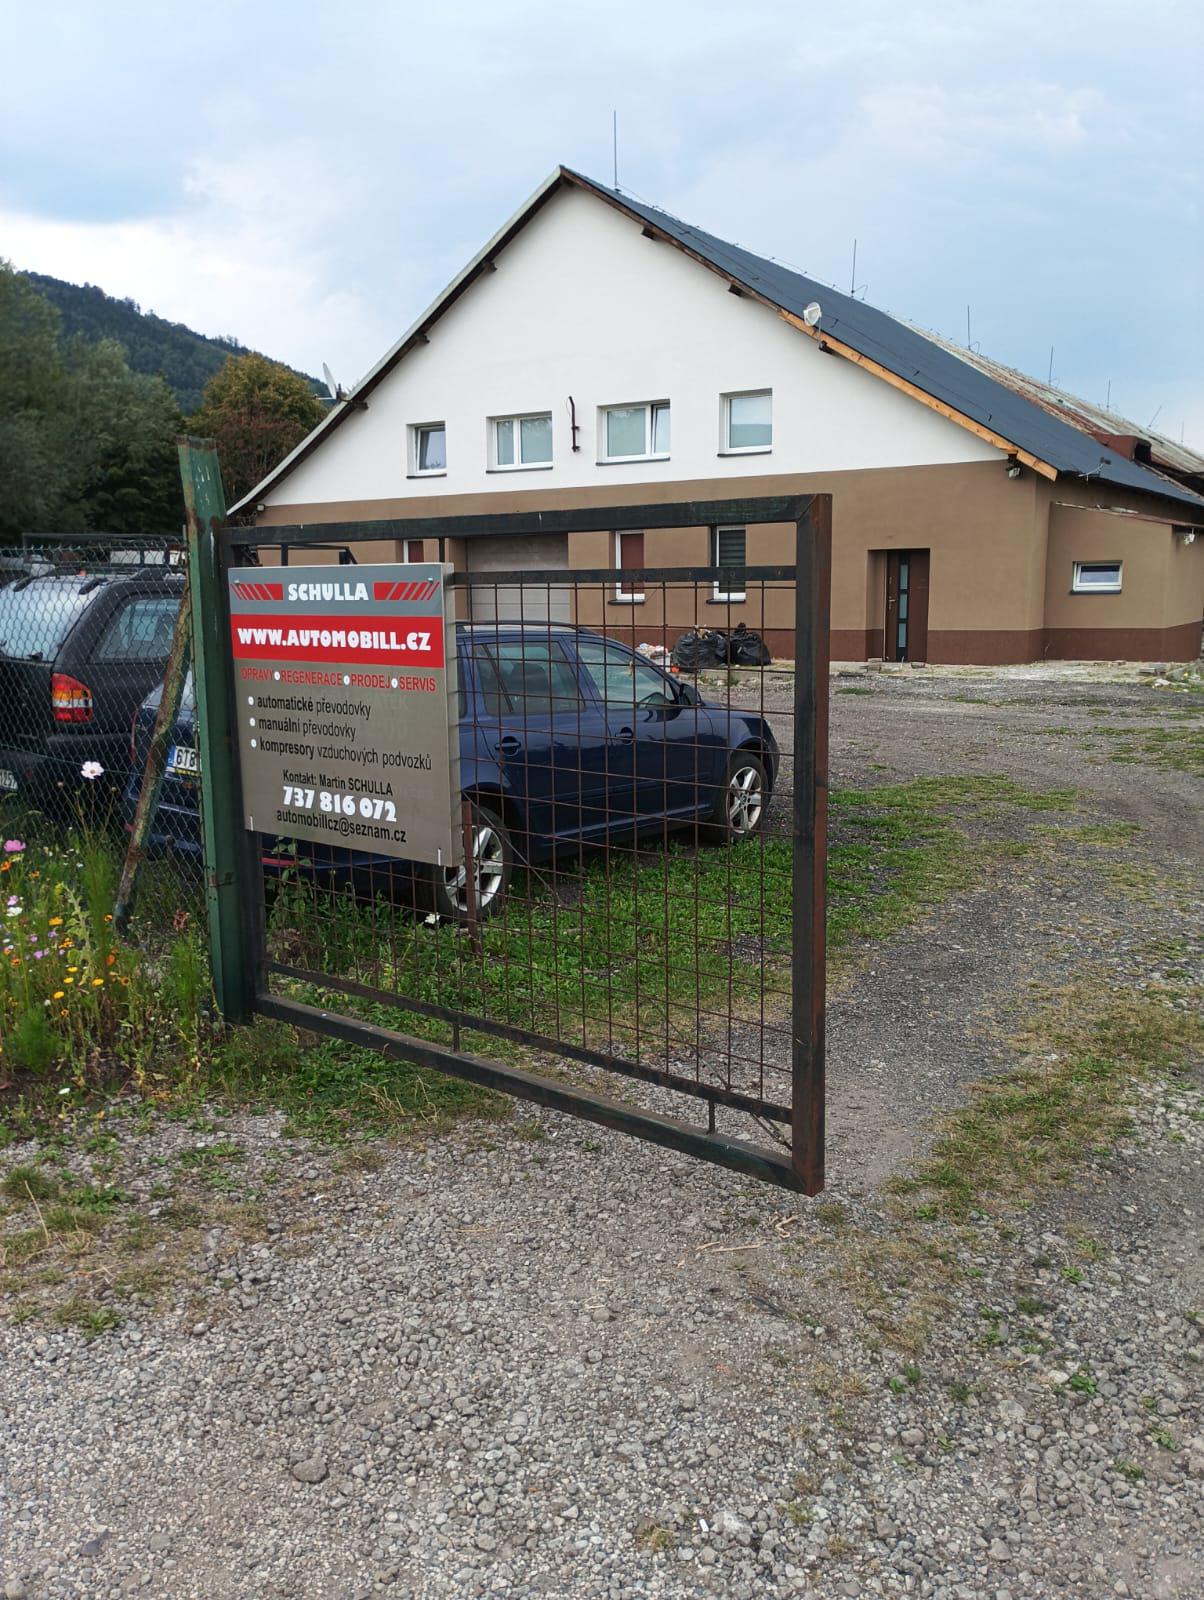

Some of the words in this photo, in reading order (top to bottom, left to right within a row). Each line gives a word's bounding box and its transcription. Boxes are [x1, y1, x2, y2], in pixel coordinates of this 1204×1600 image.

[288, 582, 369, 601] SCHULLA
[237, 628, 432, 651] WWW.AUTOMOBILL.CZ
[240, 667, 274, 681] OPRAVY
[280, 669, 343, 686] REGENERACE
[350, 672, 391, 689] PRODEJ
[399, 676, 437, 692] SERVIS
[257, 696, 314, 712] automatické
[316, 698, 371, 720] převodovky
[258, 717, 300, 733] manuální
[303, 720, 356, 742] převodovky
[260, 736, 315, 760] kompresory
[318, 744, 378, 766] vzduchových
[382, 751, 432, 771] podvozků
[282, 769, 317, 785] Kontakt:
[319, 773, 346, 790] Martin
[348, 778, 393, 796] SCHULLA
[283, 785, 315, 809] 737
[319, 791, 356, 816] 816
[359, 797, 397, 822] 072
[276, 808, 407, 843] automobillcz@seznam.cz
